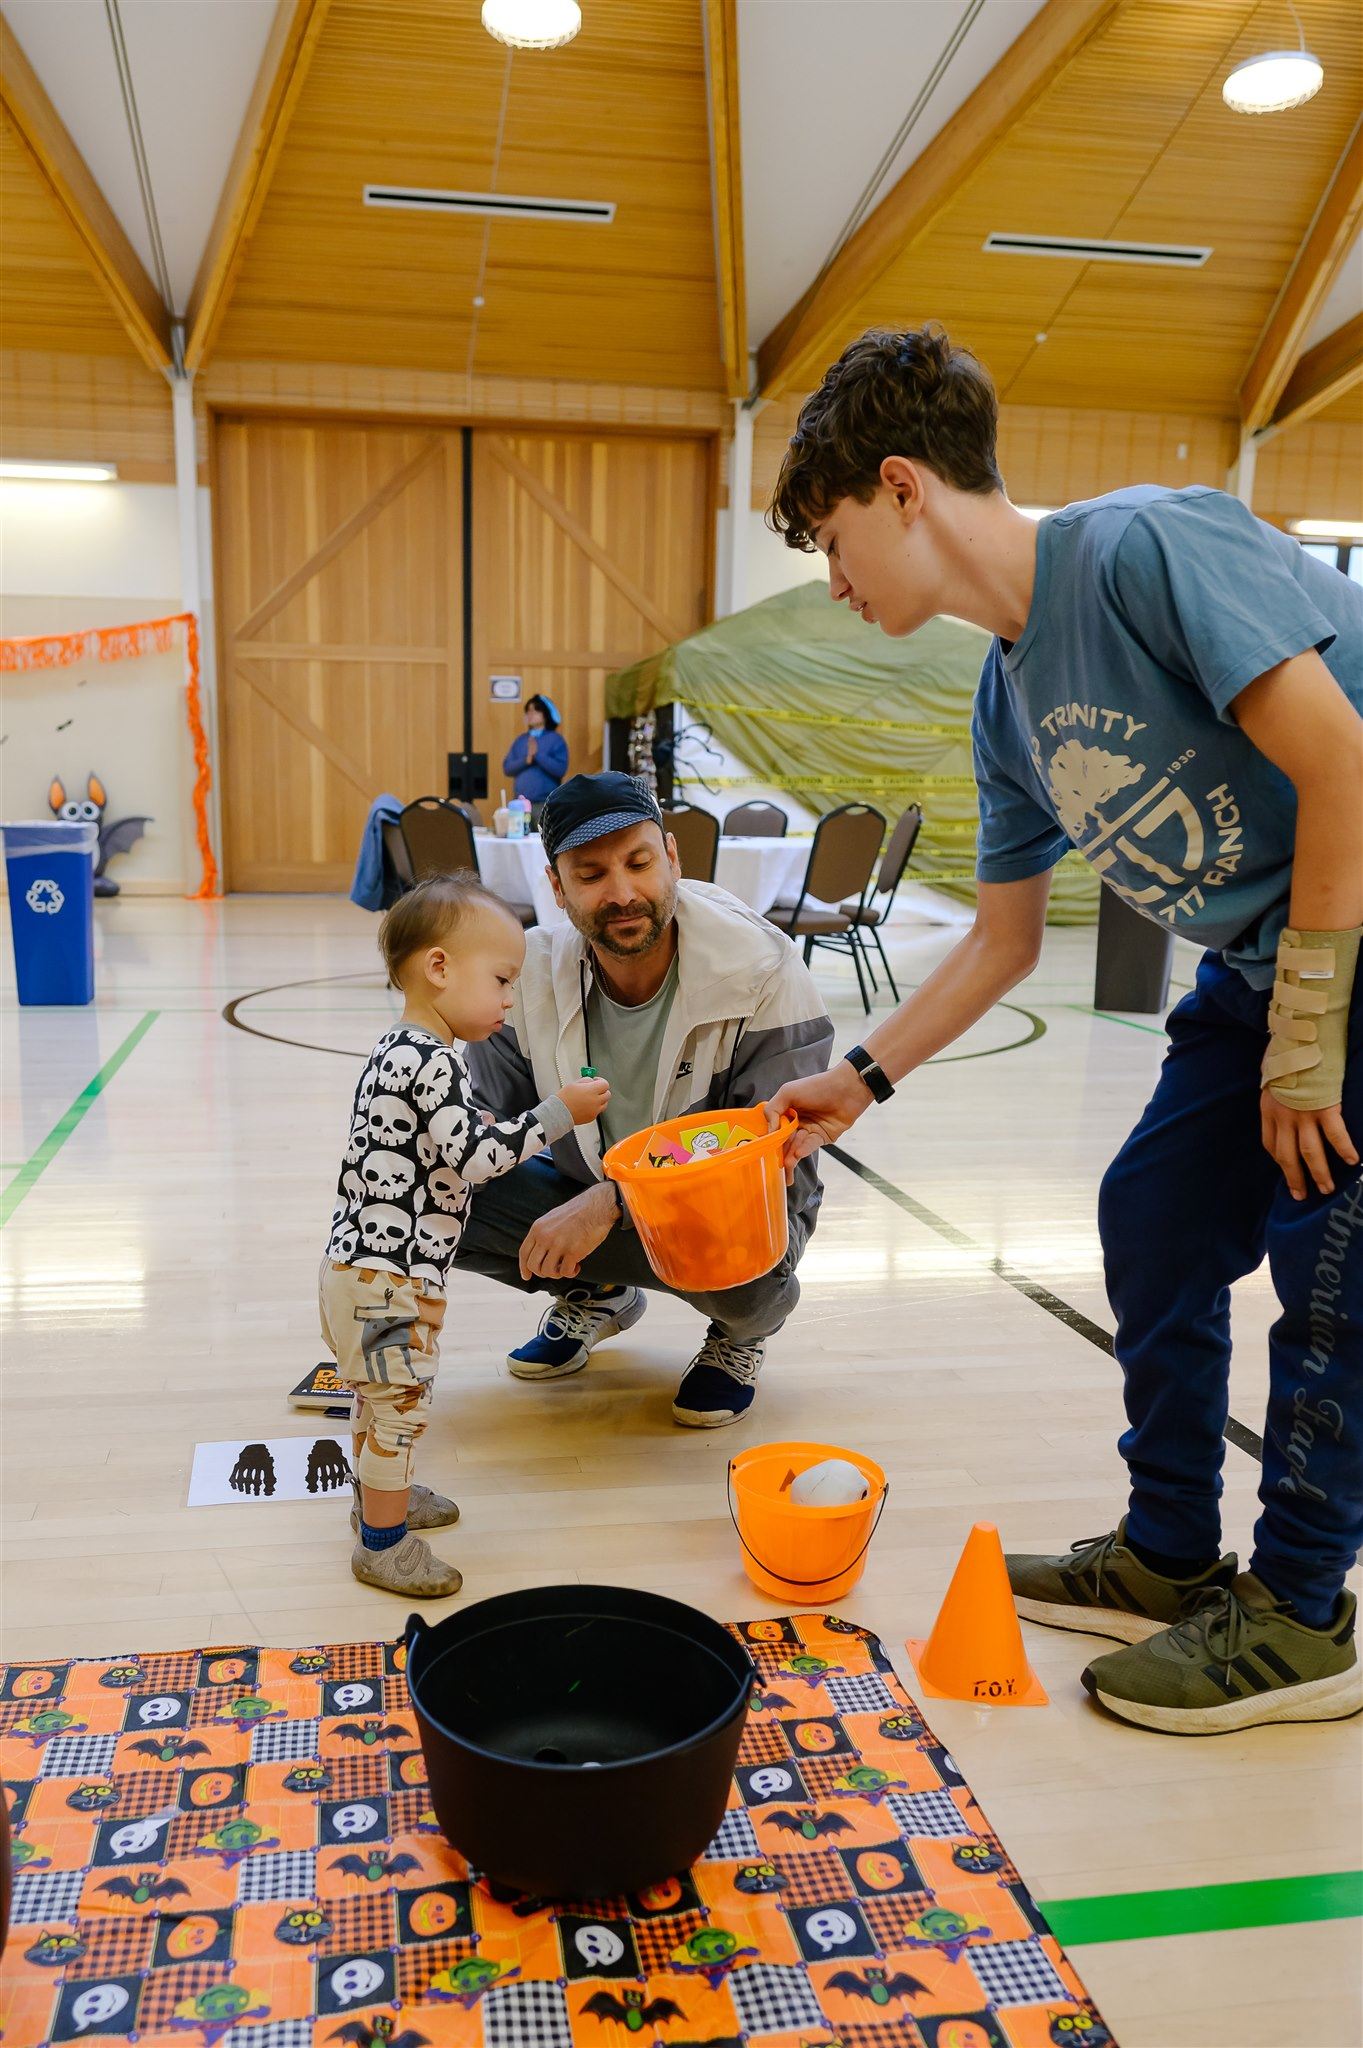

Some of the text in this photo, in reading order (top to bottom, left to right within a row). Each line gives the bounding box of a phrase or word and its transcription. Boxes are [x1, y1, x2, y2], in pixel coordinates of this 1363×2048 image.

[1040, 702, 1148, 740] TRINITY
[1166, 748, 1197, 775] 1930
[780, 775, 823, 785] CAUTION
[832, 775, 874, 785] CAUTION
[882, 775, 924, 785] CAUTION
[1158, 783, 1244, 924] 717 RANCH
